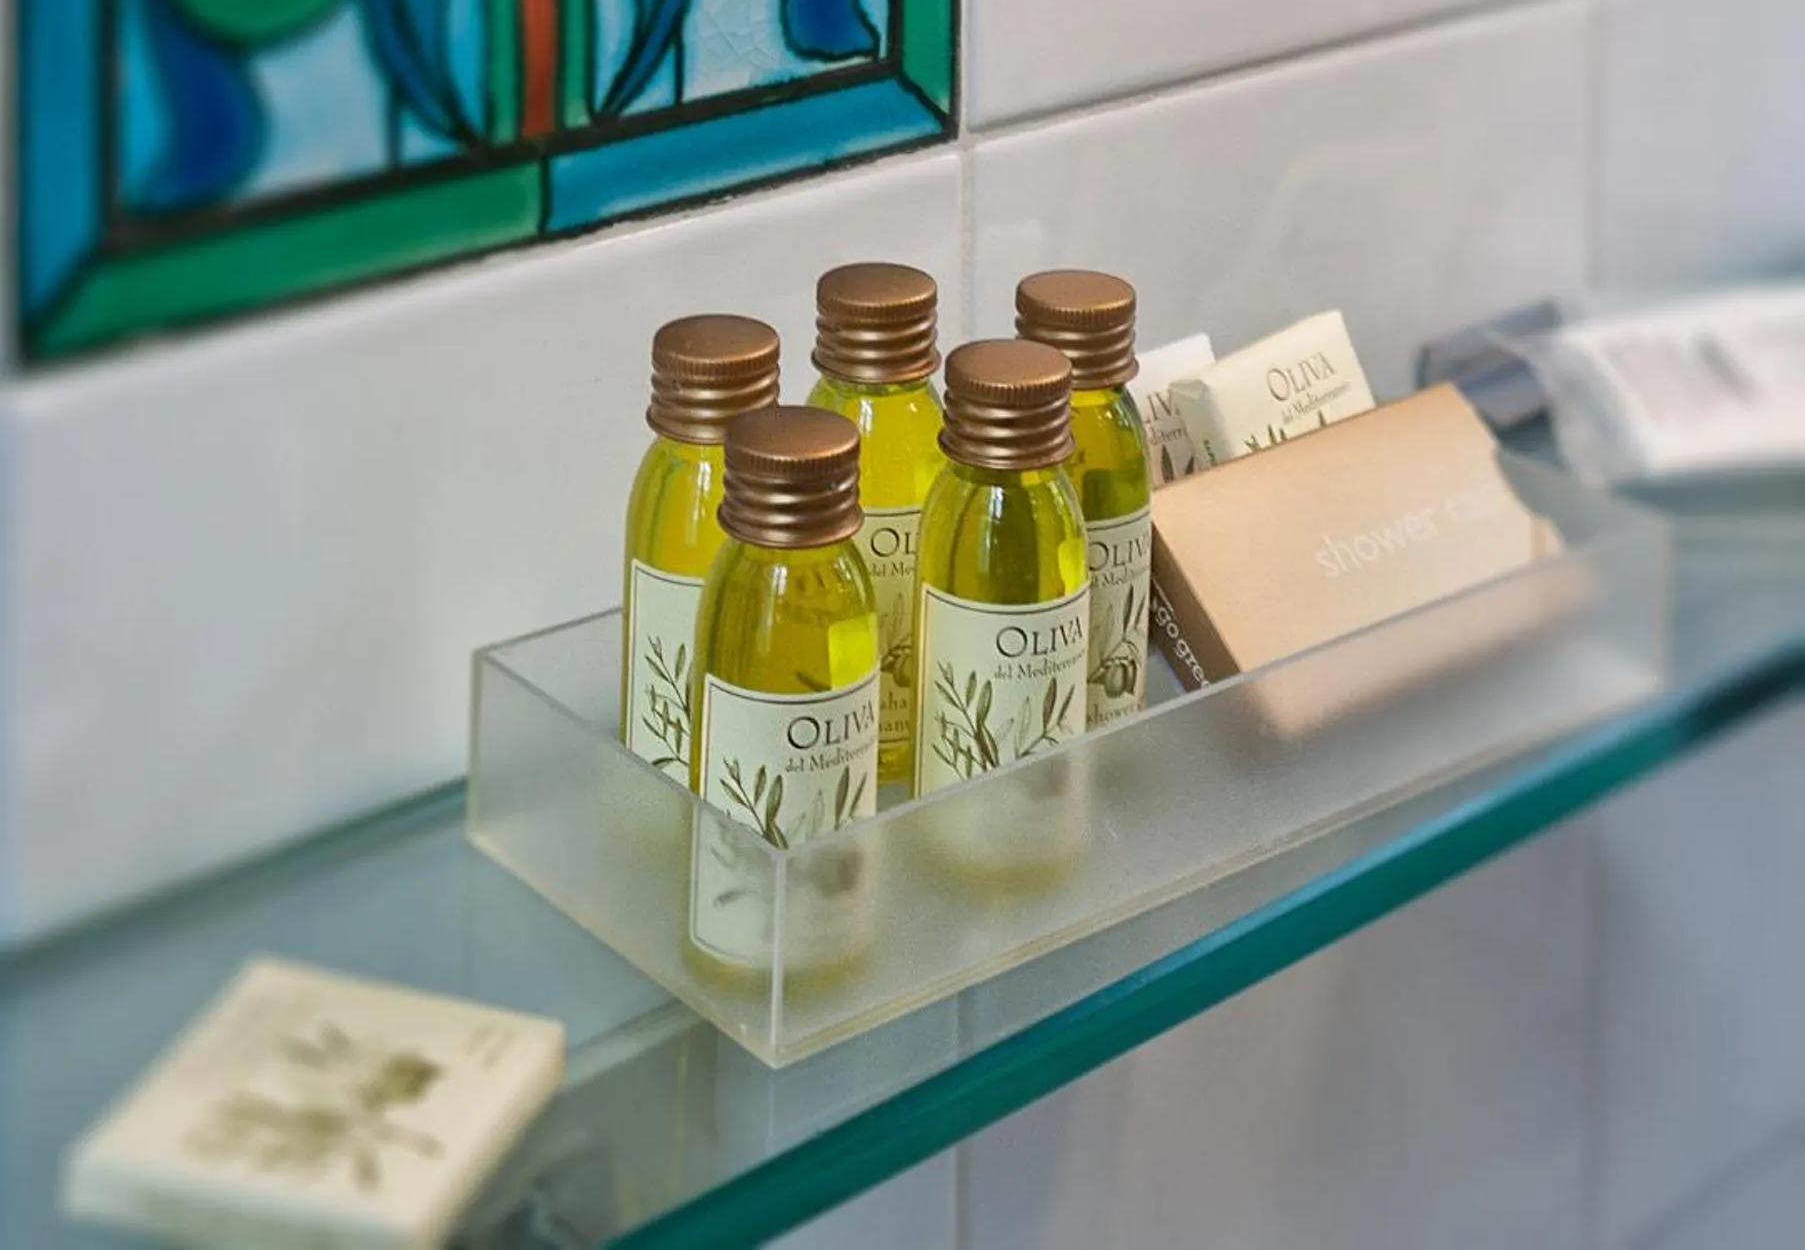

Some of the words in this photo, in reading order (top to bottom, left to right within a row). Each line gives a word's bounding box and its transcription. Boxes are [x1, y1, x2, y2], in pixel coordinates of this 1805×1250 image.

[1266, 352, 1337, 402] OLIVA
[1314, 507, 1439, 578] shower
[996, 615, 1083, 658] OLIVA
[787, 699, 875, 750] OLIVA
